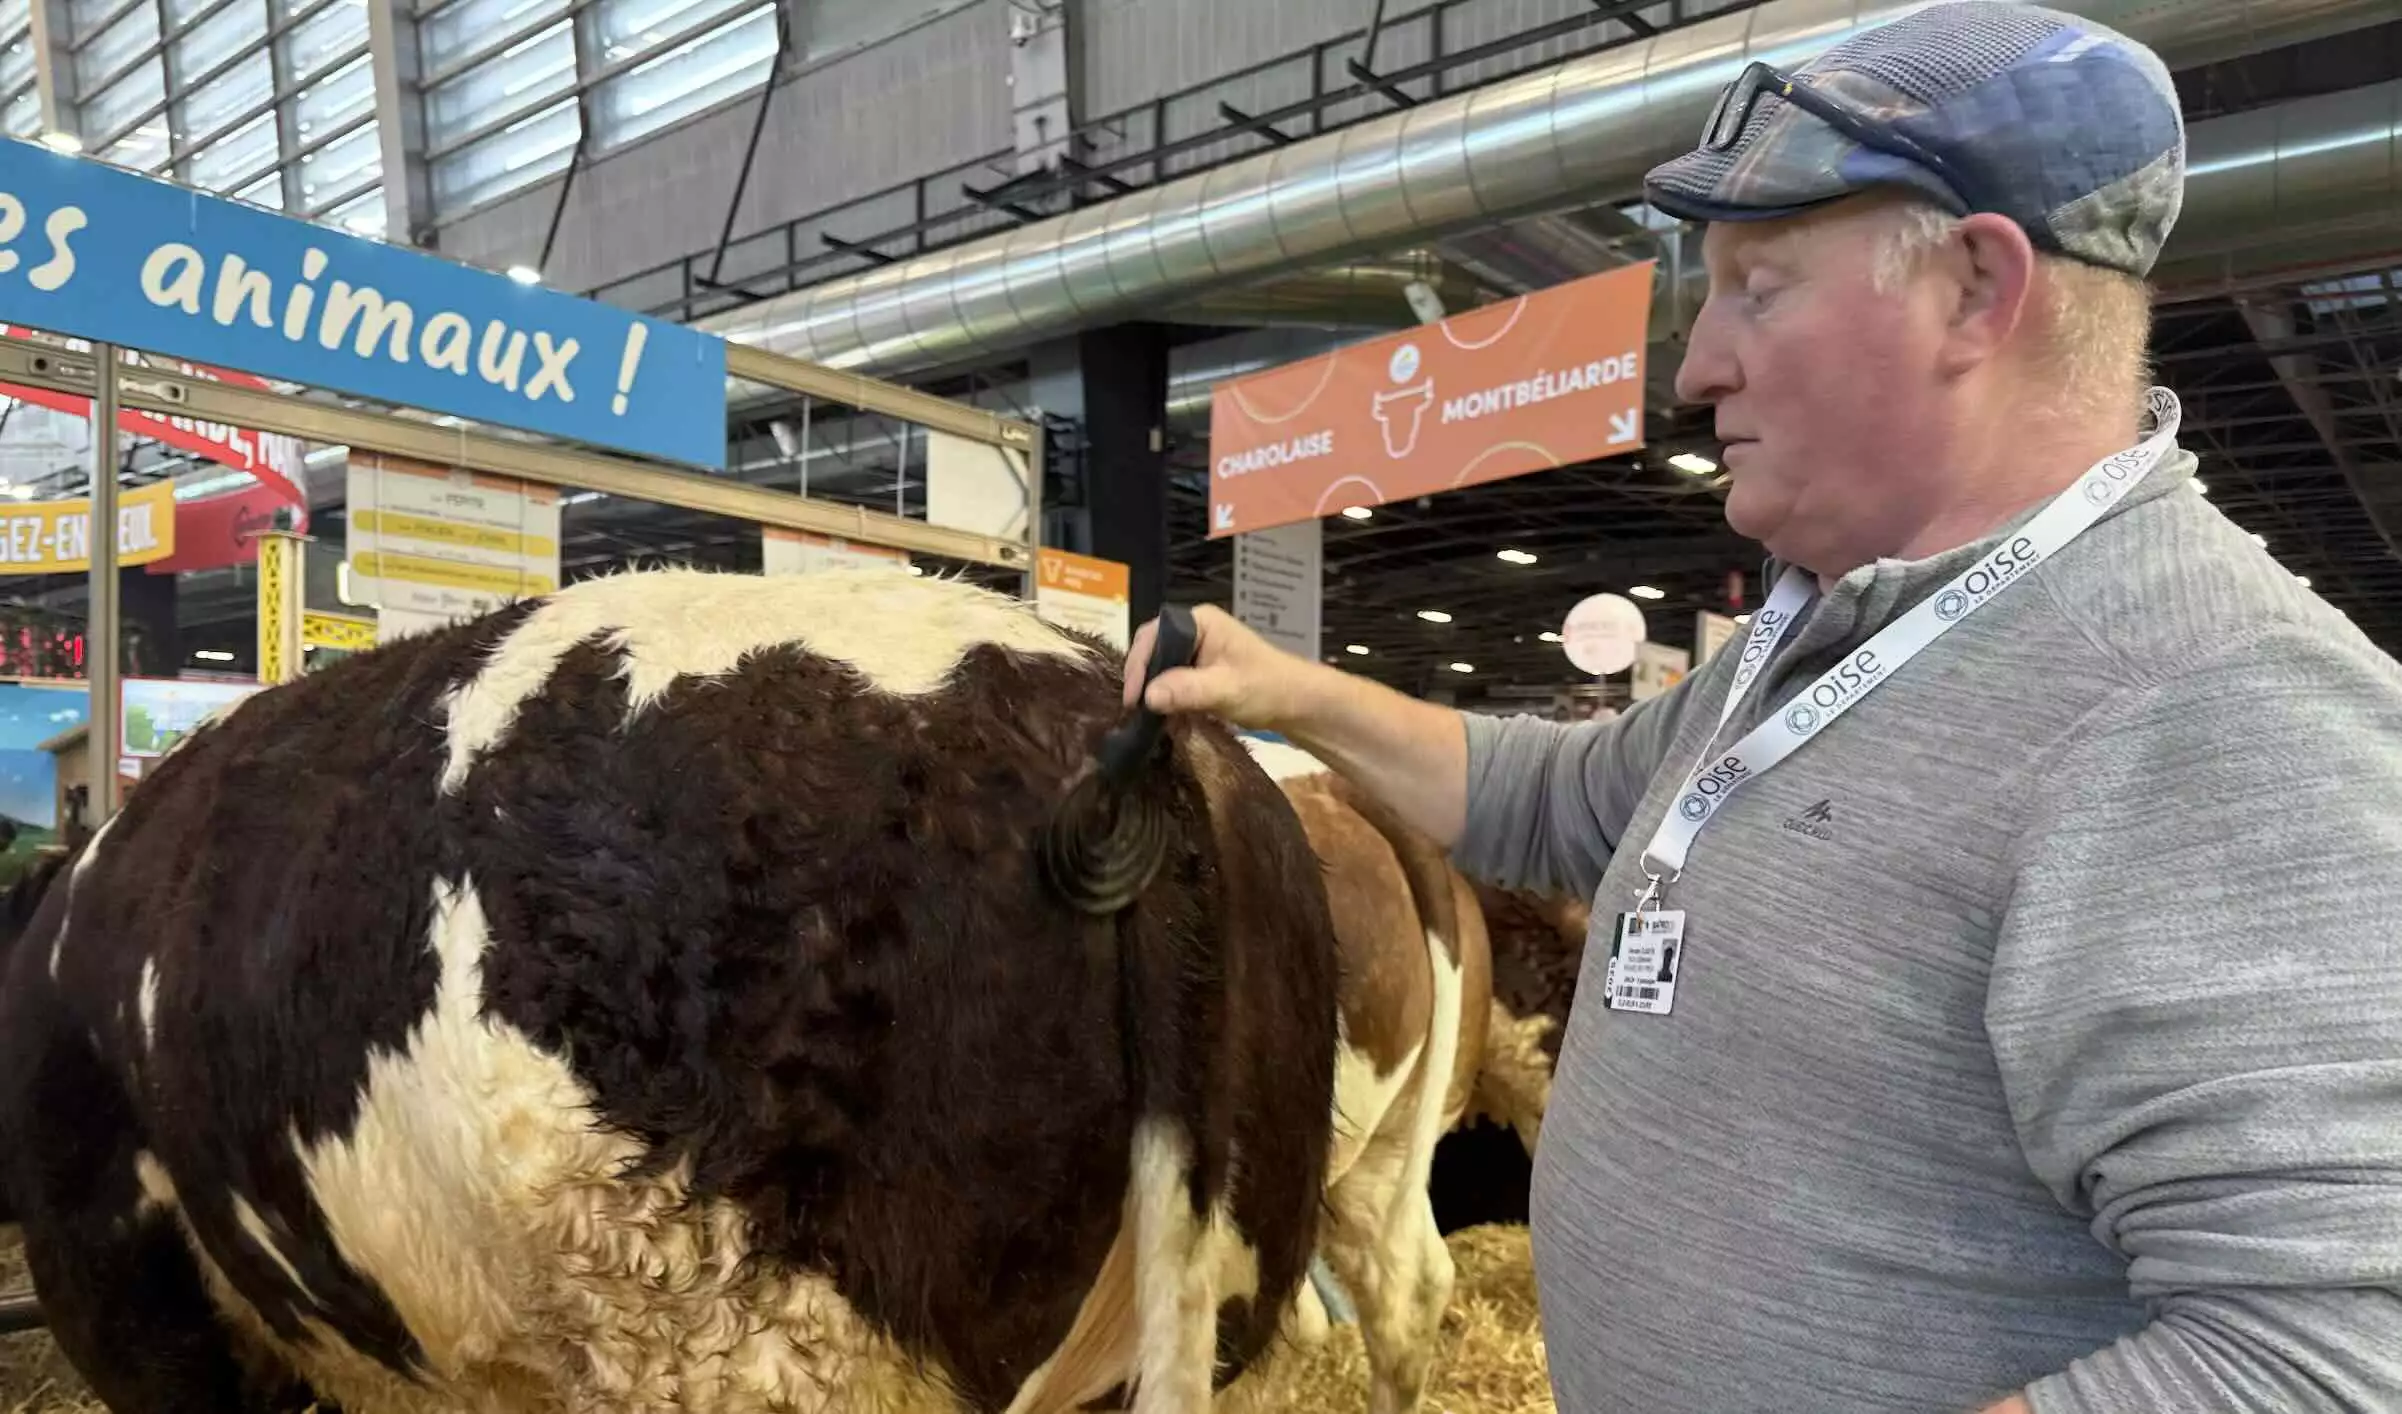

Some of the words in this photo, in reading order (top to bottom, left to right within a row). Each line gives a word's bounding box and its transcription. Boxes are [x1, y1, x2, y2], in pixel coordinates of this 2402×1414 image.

[140, 241, 581, 404] animaux
[611, 320, 648, 416] !
[1441, 351, 1638, 425] MONTBÉLIARDE
[1216, 429, 1335, 480] CHAROLAISE
